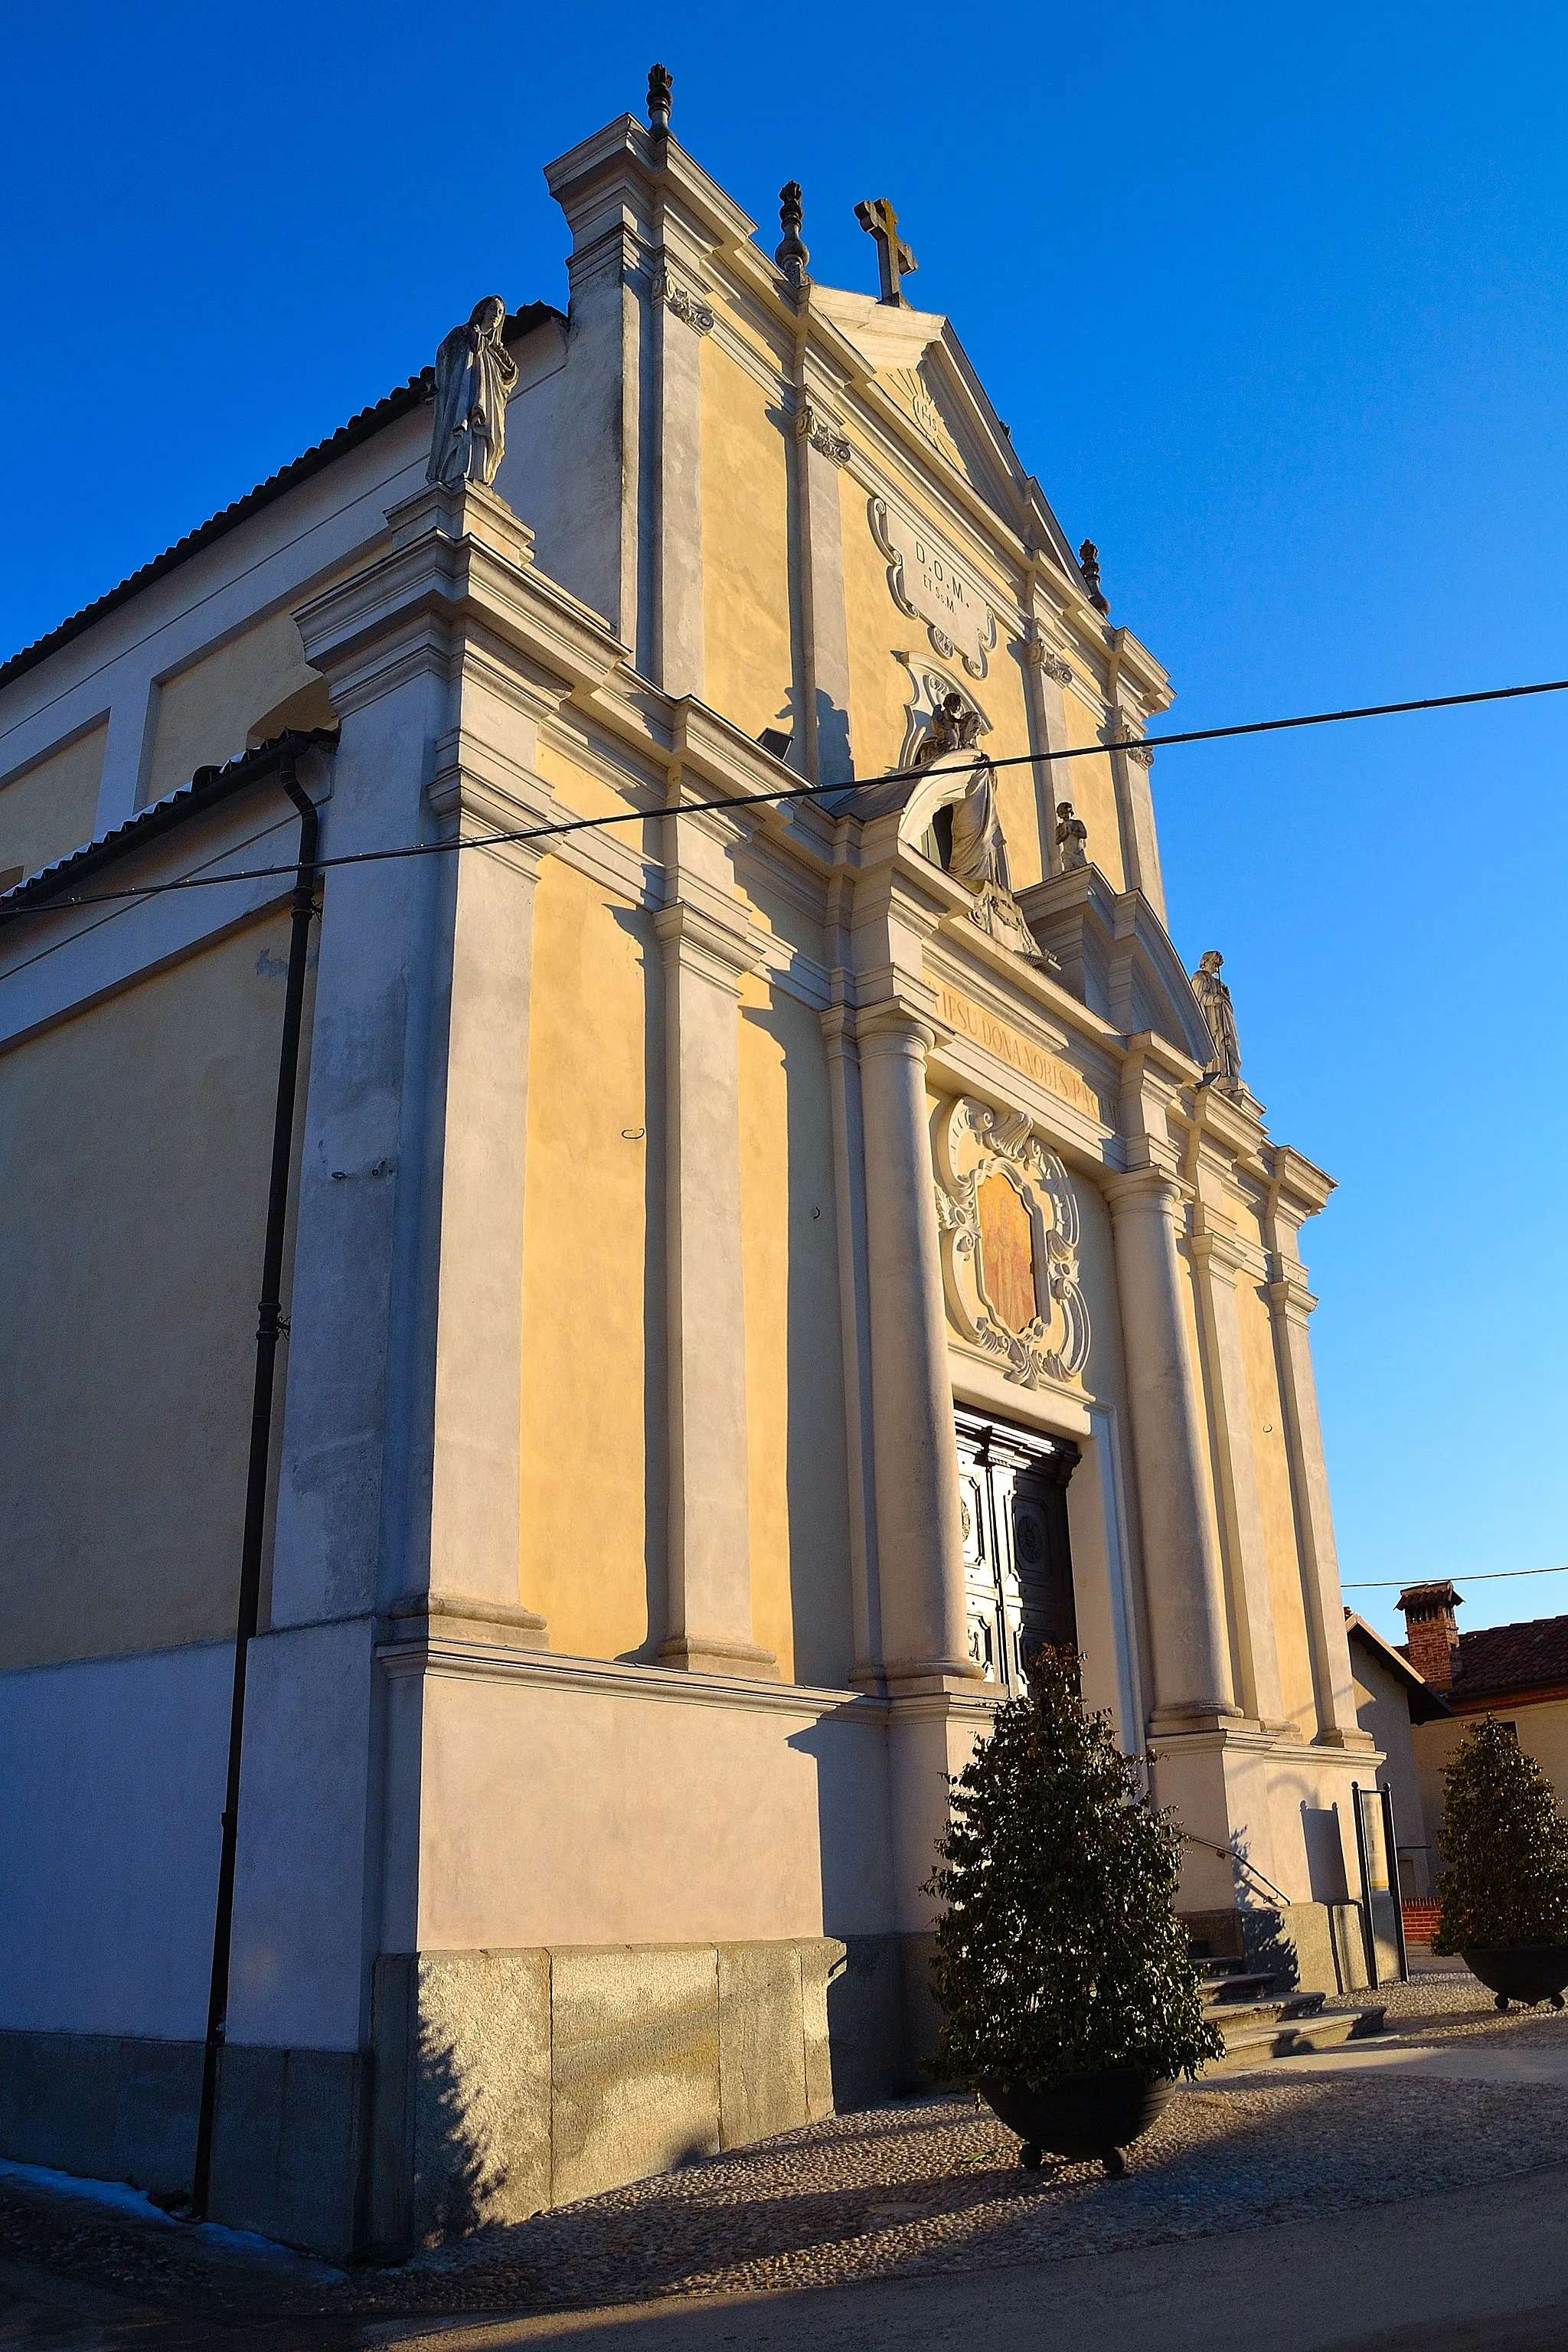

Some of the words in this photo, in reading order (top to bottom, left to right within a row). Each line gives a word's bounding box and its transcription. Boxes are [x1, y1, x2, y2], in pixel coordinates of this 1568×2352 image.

[923, 574, 932, 591] ET
[942, 990, 978, 1034] IESU
[982, 1019, 1021, 1067] DONA
[1024, 1046, 1068, 1096] NOBIS
